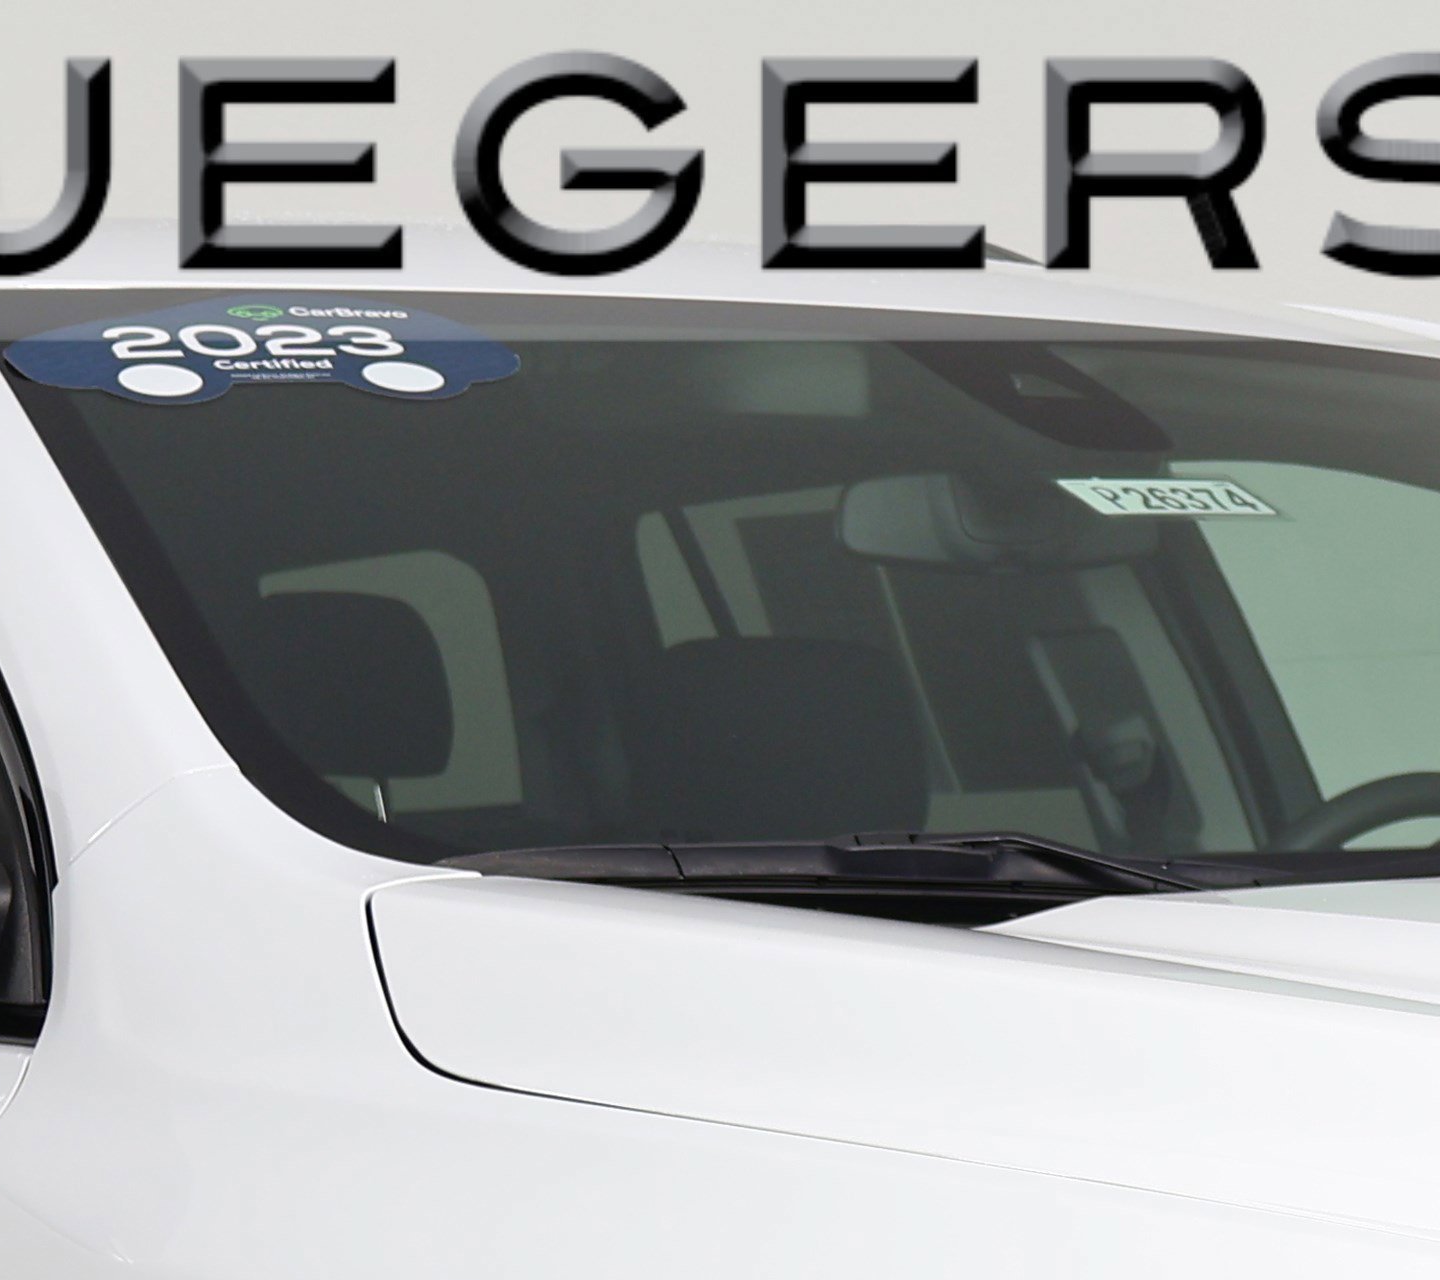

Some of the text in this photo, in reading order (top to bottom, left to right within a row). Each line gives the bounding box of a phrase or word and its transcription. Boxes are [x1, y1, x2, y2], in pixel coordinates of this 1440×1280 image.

[288, 305, 409, 320] CarBravo
[101, 324, 405, 358] 2023
[213, 358, 335, 371] Certified
